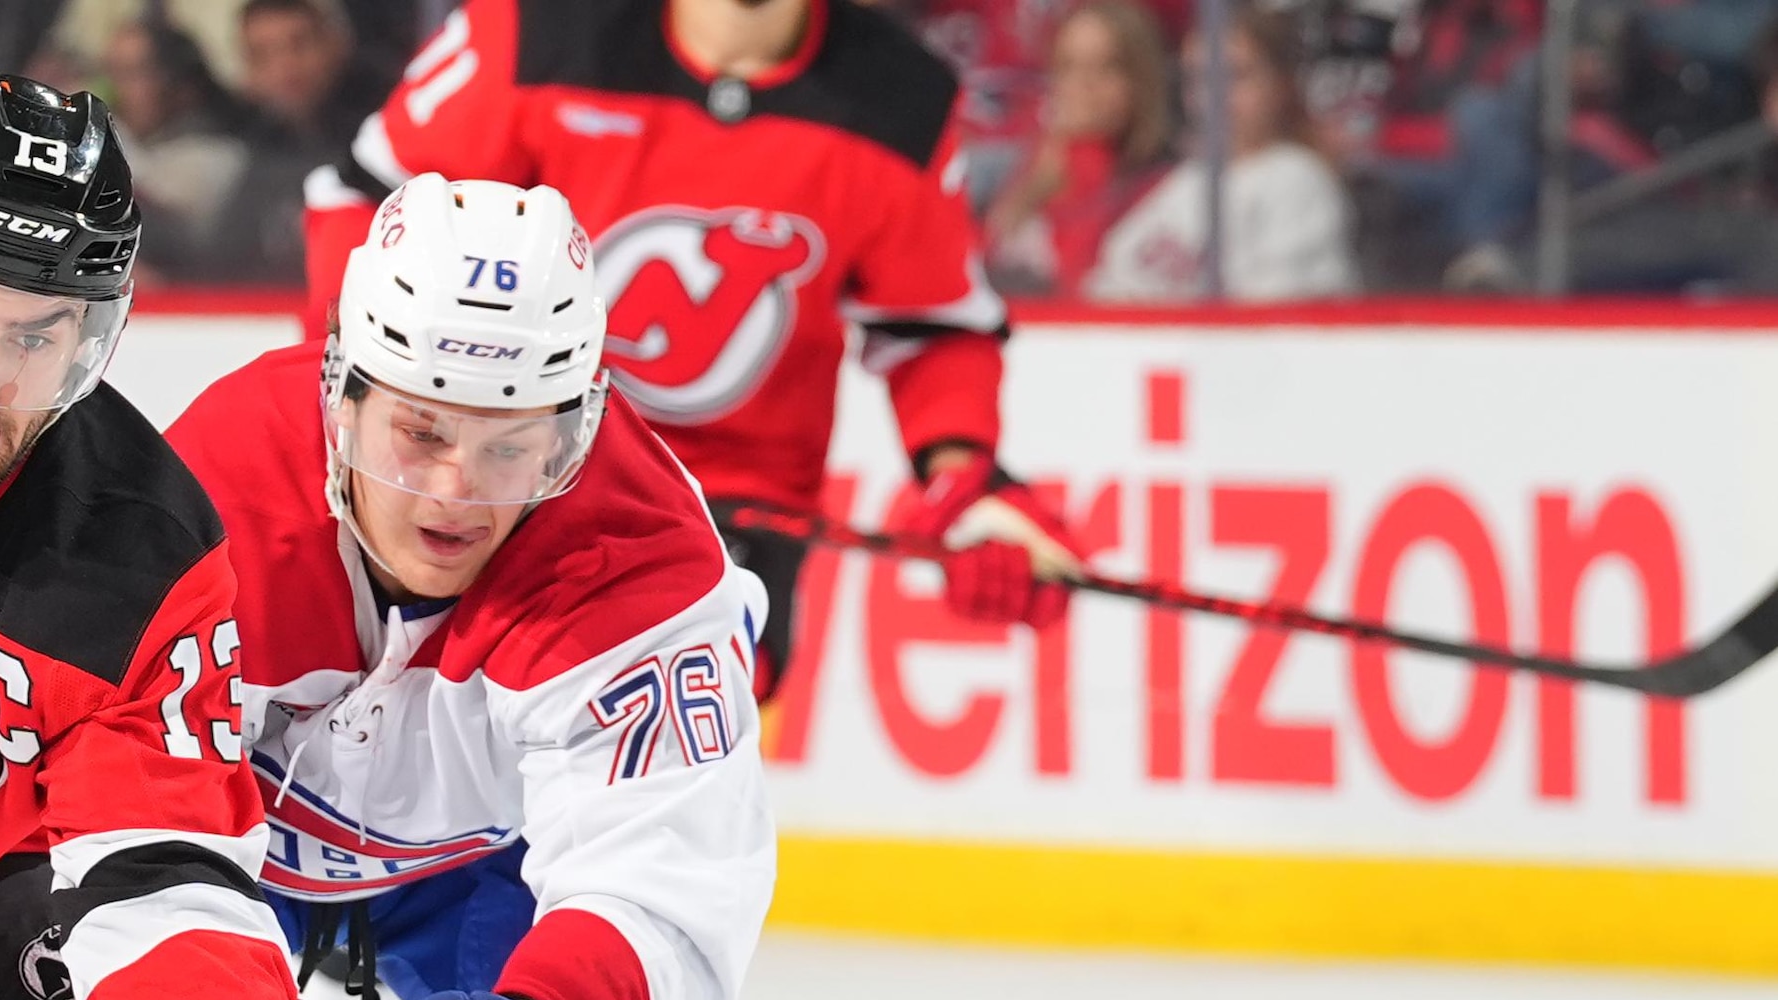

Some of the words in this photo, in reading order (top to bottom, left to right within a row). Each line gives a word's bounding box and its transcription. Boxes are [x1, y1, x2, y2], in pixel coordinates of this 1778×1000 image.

[14, 133, 68, 176] 13
[463, 255, 519, 292] 76
[437, 338, 524, 360] CCM
[587, 643, 733, 787] 76
